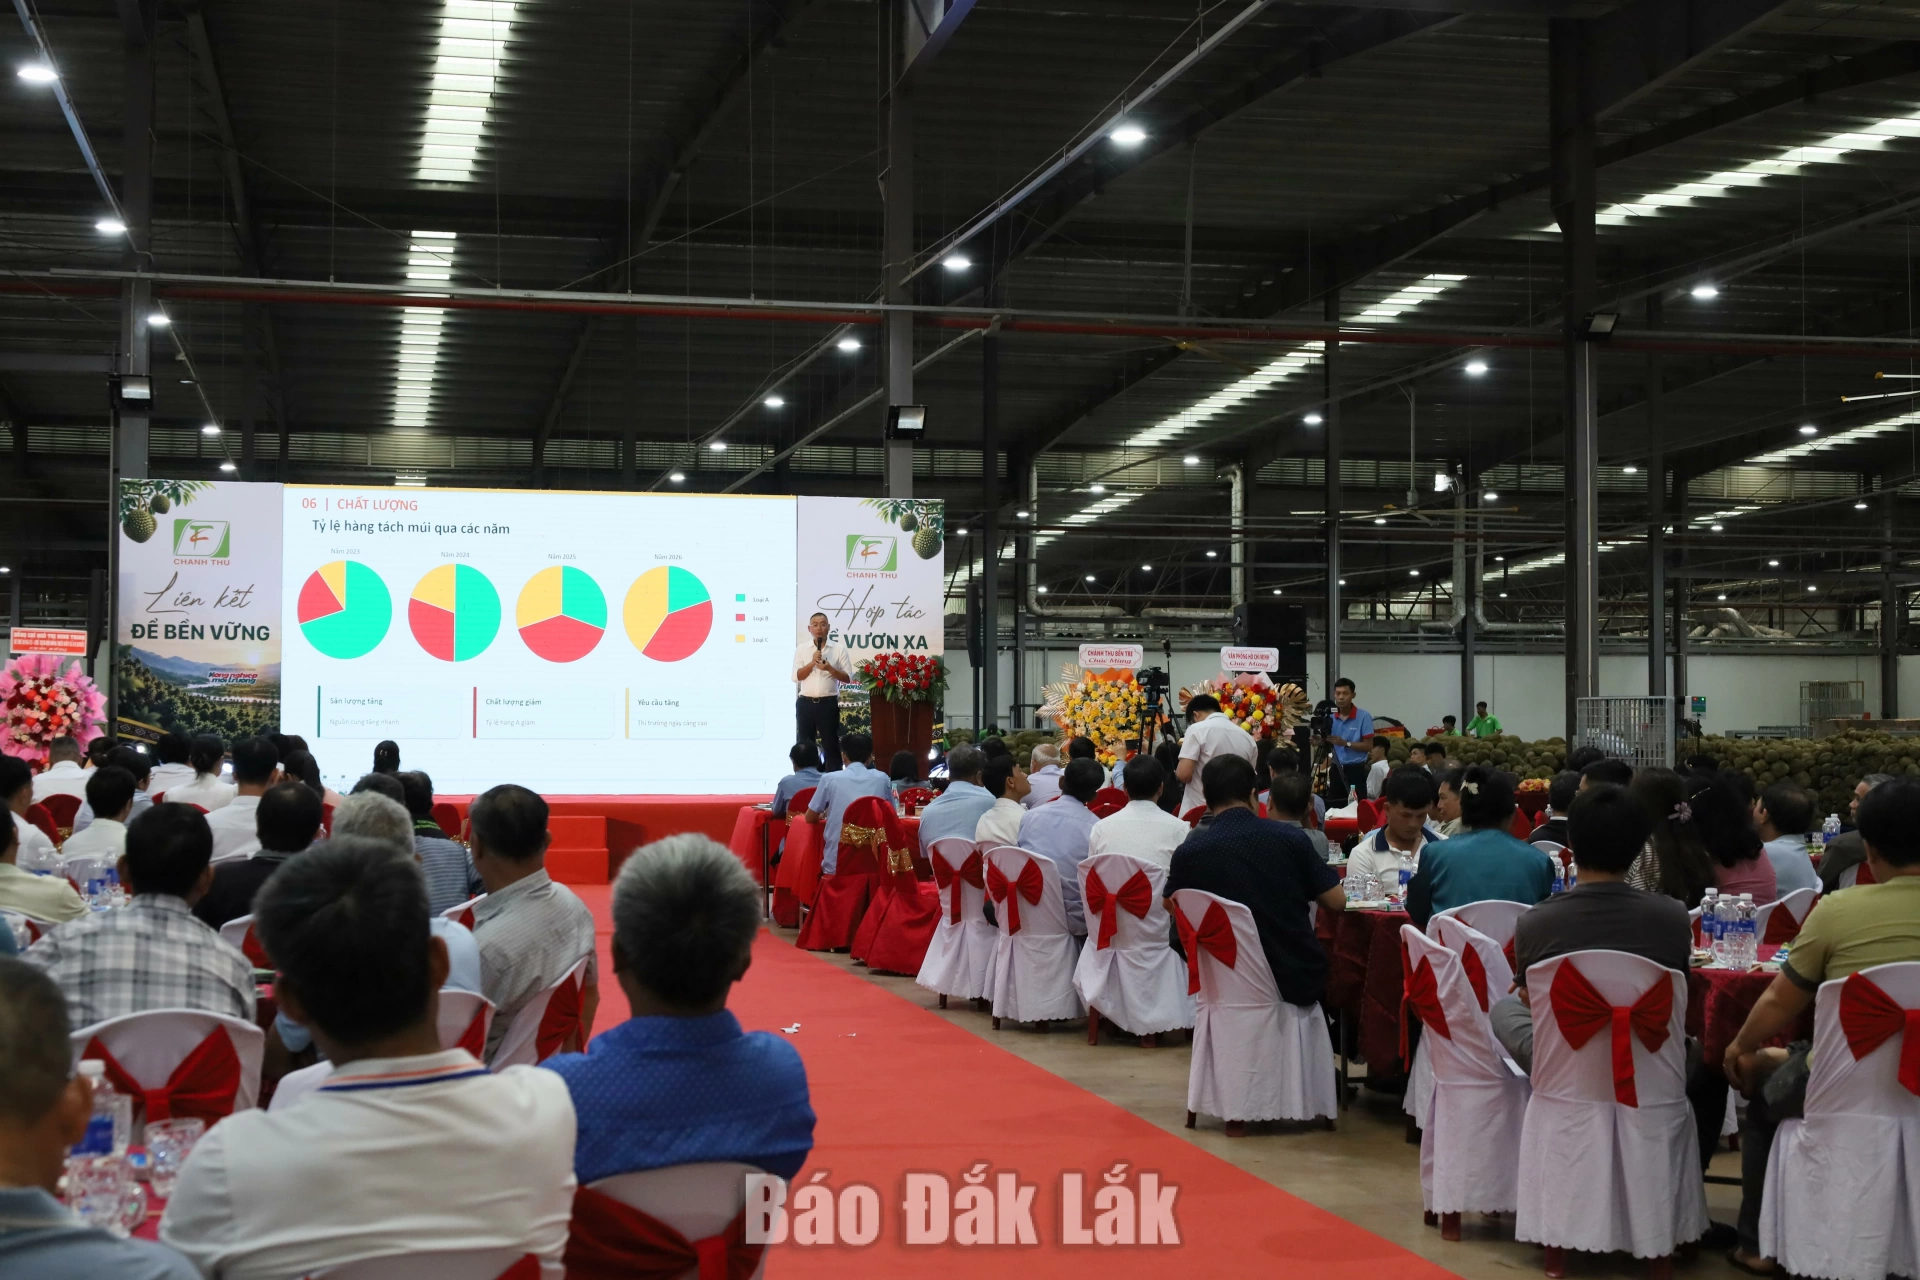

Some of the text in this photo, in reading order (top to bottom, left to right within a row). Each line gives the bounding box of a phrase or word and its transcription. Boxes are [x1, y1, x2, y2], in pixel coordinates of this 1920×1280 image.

[302, 497, 317, 509] 06
[337, 495, 369, 510] CHẤT
[373, 499, 418, 513] LƯỢNG
[312, 519, 510, 536] Tỷ lệ hàng tách múi qua các năm
[173, 558, 208, 566] CHANH
[846, 571, 898, 580] CHANH THU
[144, 571, 255, 615] Liên kết
[816, 584, 926, 631] Hợp tác
[130, 617, 270, 641] ĐỂ BỀN VỮNG
[843, 631, 898, 649] VƯƠN
[903, 634, 929, 650] XA
[344, 697, 366, 705] lượng
[367, 697, 383, 706] tăng
[485, 697, 501, 705] Chất
[502, 698, 524, 706] lượng
[638, 698, 650, 706] Yêu
[664, 699, 680, 707] tăng
